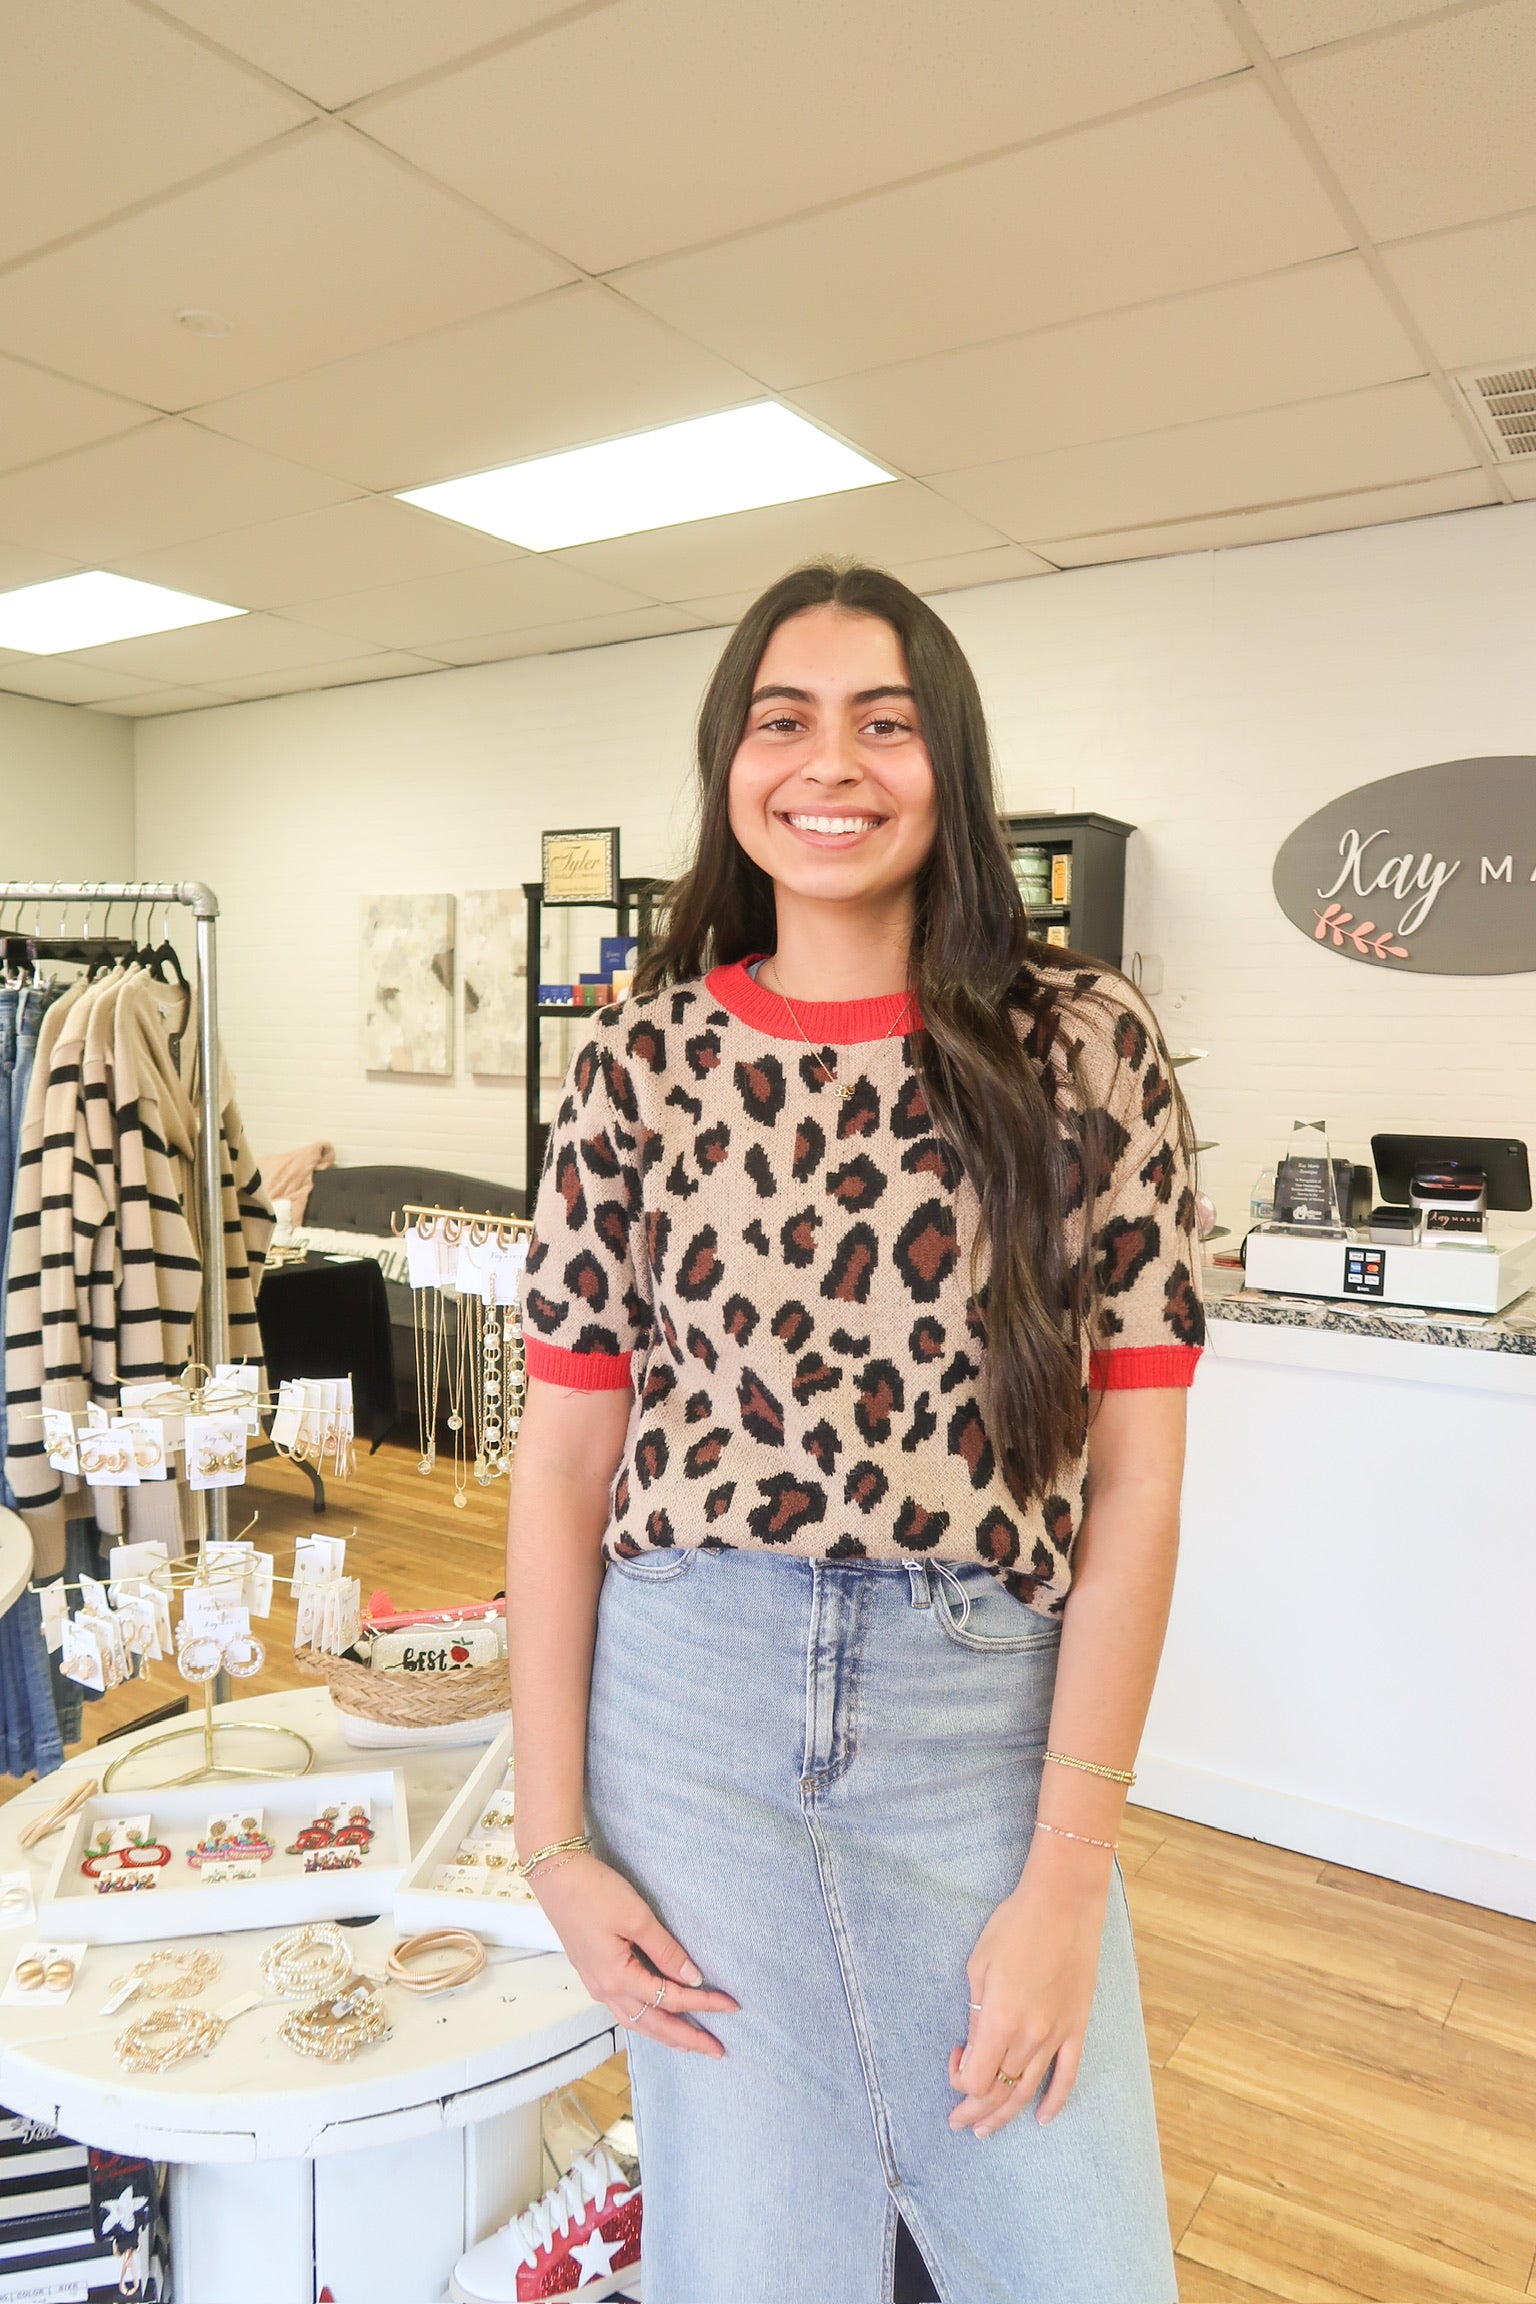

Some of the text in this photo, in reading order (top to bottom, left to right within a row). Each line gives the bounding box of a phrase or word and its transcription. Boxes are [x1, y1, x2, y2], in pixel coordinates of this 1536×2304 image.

[550, 846, 601, 879] Tyler
[1316, 828, 1536, 936] Kay M
